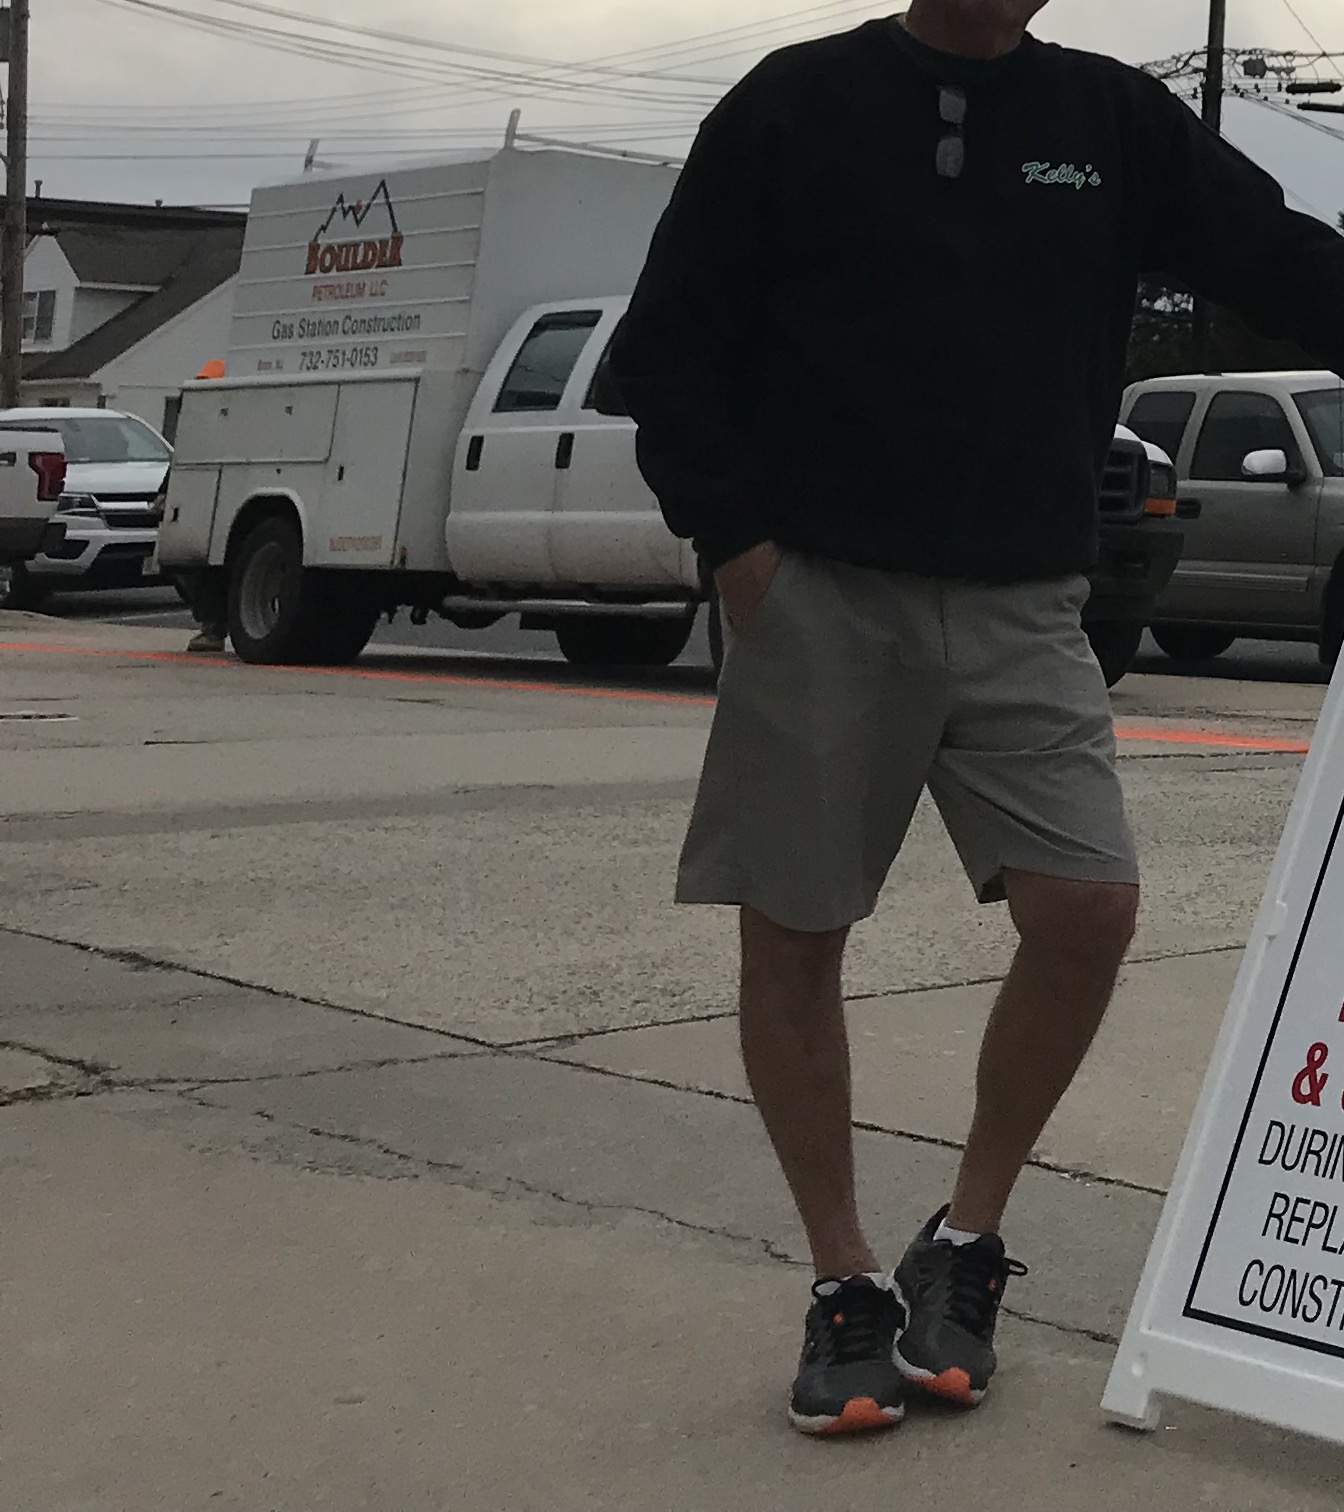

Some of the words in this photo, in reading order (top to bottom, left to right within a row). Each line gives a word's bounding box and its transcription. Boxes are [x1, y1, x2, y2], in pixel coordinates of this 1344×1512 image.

[1021, 161, 1102, 190] Kelly's
[272, 320, 294, 339] Gas
[299, 317, 339, 338] Station
[342, 313, 420, 335] Construction
[300, 347, 378, 370] 732-751-0153
[1290, 1042, 1330, 1106] &
